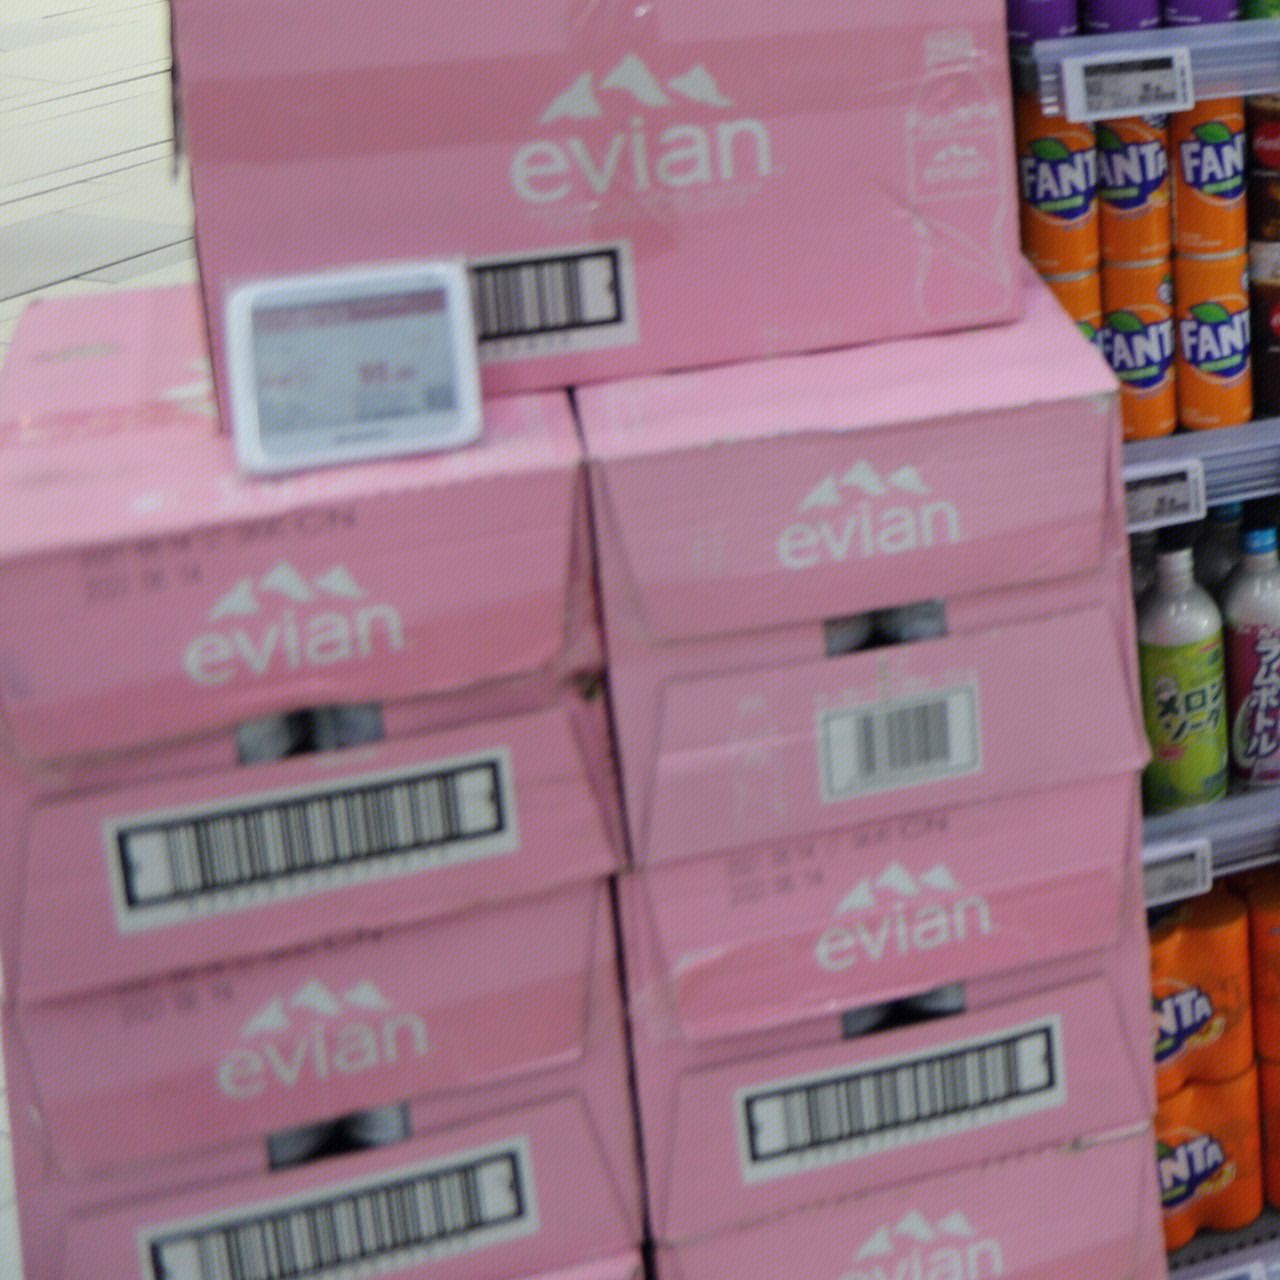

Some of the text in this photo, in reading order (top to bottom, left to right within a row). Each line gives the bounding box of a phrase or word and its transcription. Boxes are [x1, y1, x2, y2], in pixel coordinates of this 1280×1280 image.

[510, 116, 773, 205] evian
[777, 494, 960, 571] evian
[183, 598, 404, 688] evian
[815, 889, 993, 972] evian
[217, 1011, 430, 1101] evian
